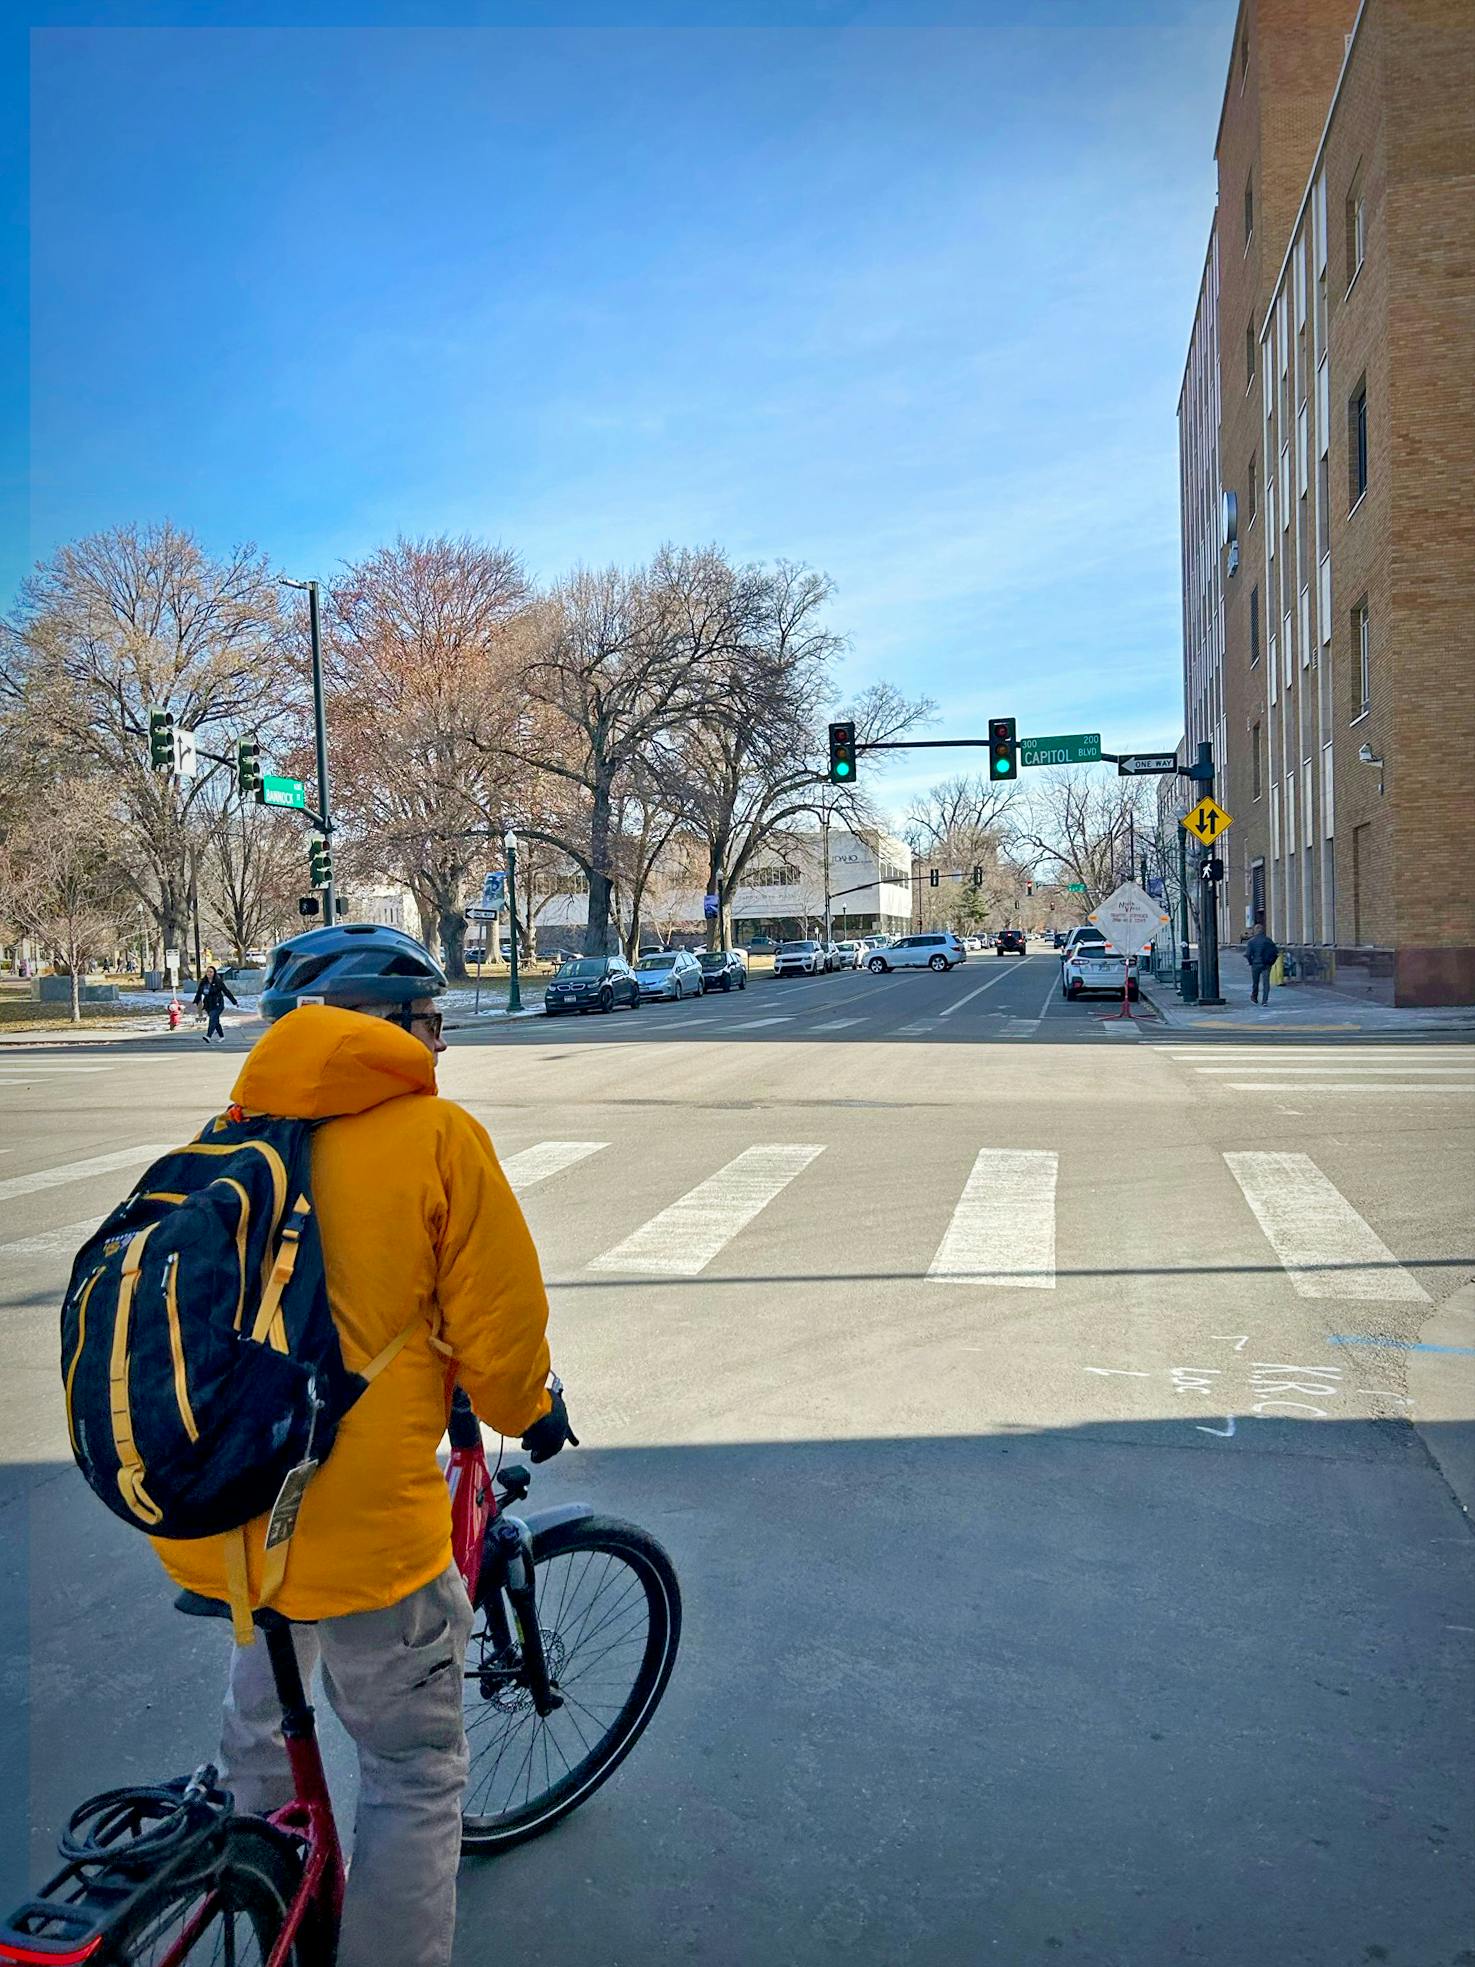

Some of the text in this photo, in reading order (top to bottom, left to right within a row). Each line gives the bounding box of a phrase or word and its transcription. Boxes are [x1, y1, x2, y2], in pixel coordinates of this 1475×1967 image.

[1022, 740, 1037, 749] 300
[1083, 735, 1099, 745] 200
[1024, 749, 1073, 765] CAPITOL
[1078, 748, 1097, 757] BLVD
[1135, 759, 1173, 768] ONE WAY
